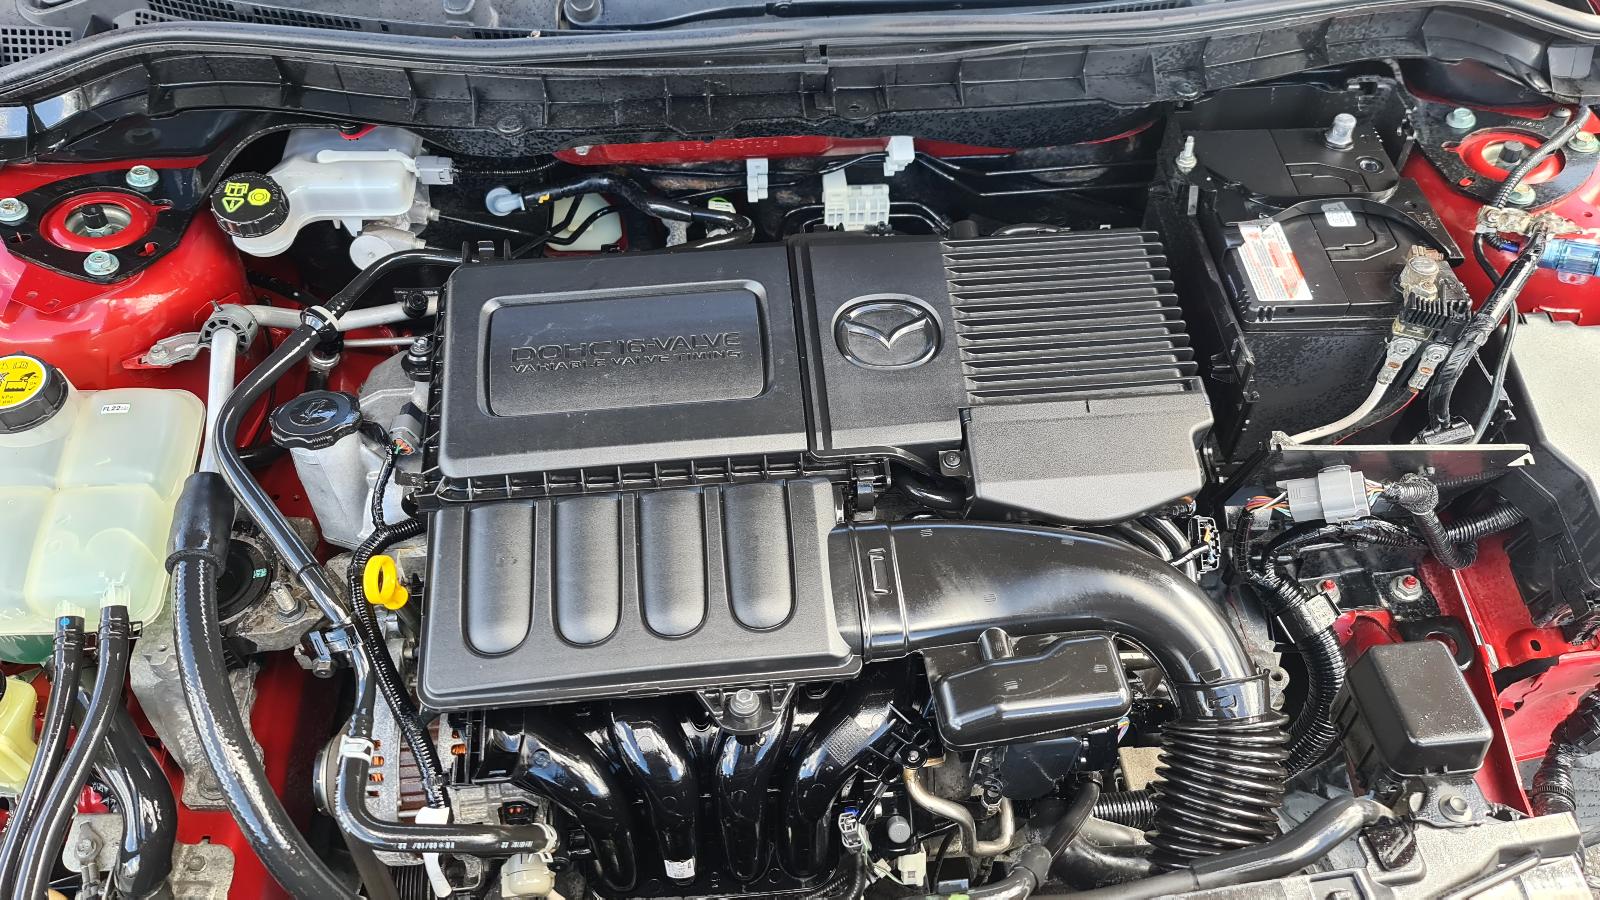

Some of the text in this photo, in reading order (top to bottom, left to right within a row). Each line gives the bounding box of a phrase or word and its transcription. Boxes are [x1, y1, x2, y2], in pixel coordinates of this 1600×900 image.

[511, 331, 742, 362] DOHC 16-VALVE
[510, 349, 741, 374] VARIABLE VALVE TIMING
